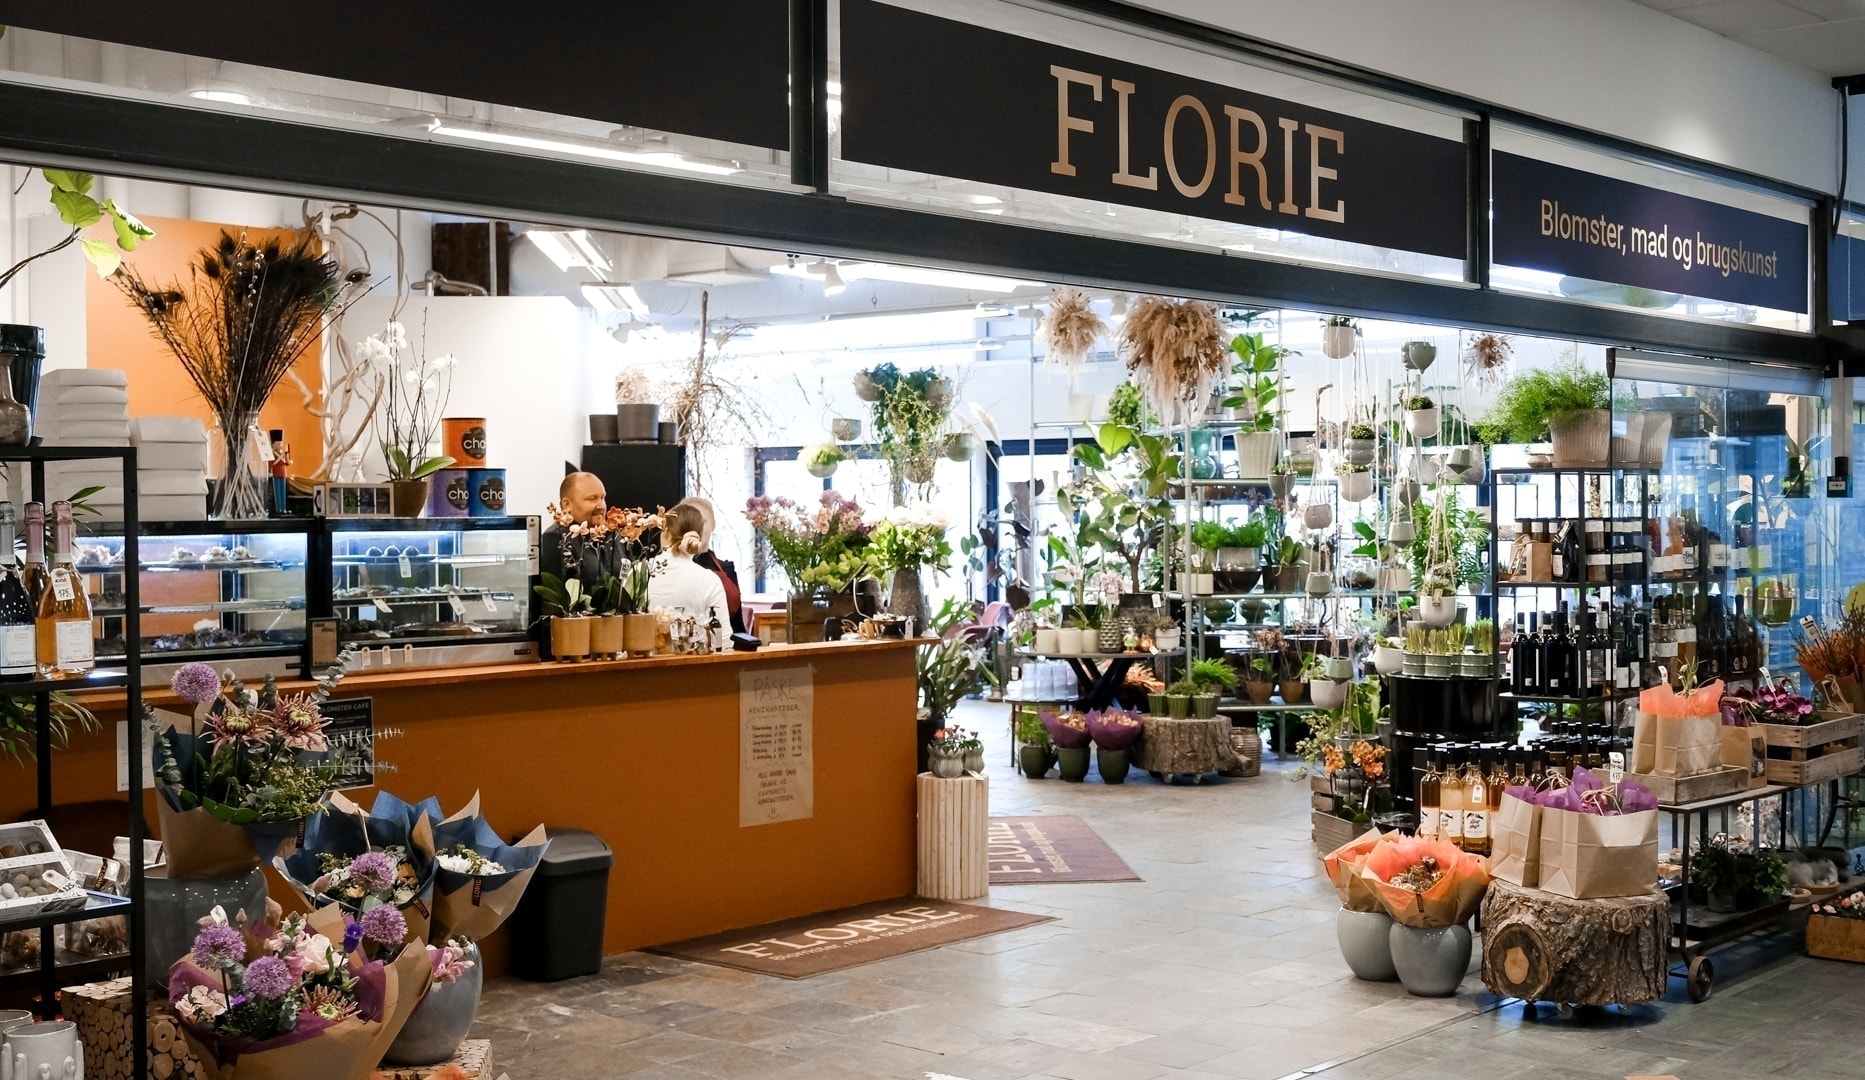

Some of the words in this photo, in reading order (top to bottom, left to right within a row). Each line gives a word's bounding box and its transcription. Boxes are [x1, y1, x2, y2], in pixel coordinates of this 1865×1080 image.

[1050, 65, 1345, 223] FLORIE
[1541, 199, 1626, 256] Blomster,
[1631, 224, 1668, 258] mad
[1672, 235, 1692, 271] og
[1696, 232, 1777, 279] brugskunst
[318, 703, 353, 713] LOMSTER
[753, 676, 797, 701] PÅSKE
[720, 906, 960, 958] FLORIE
